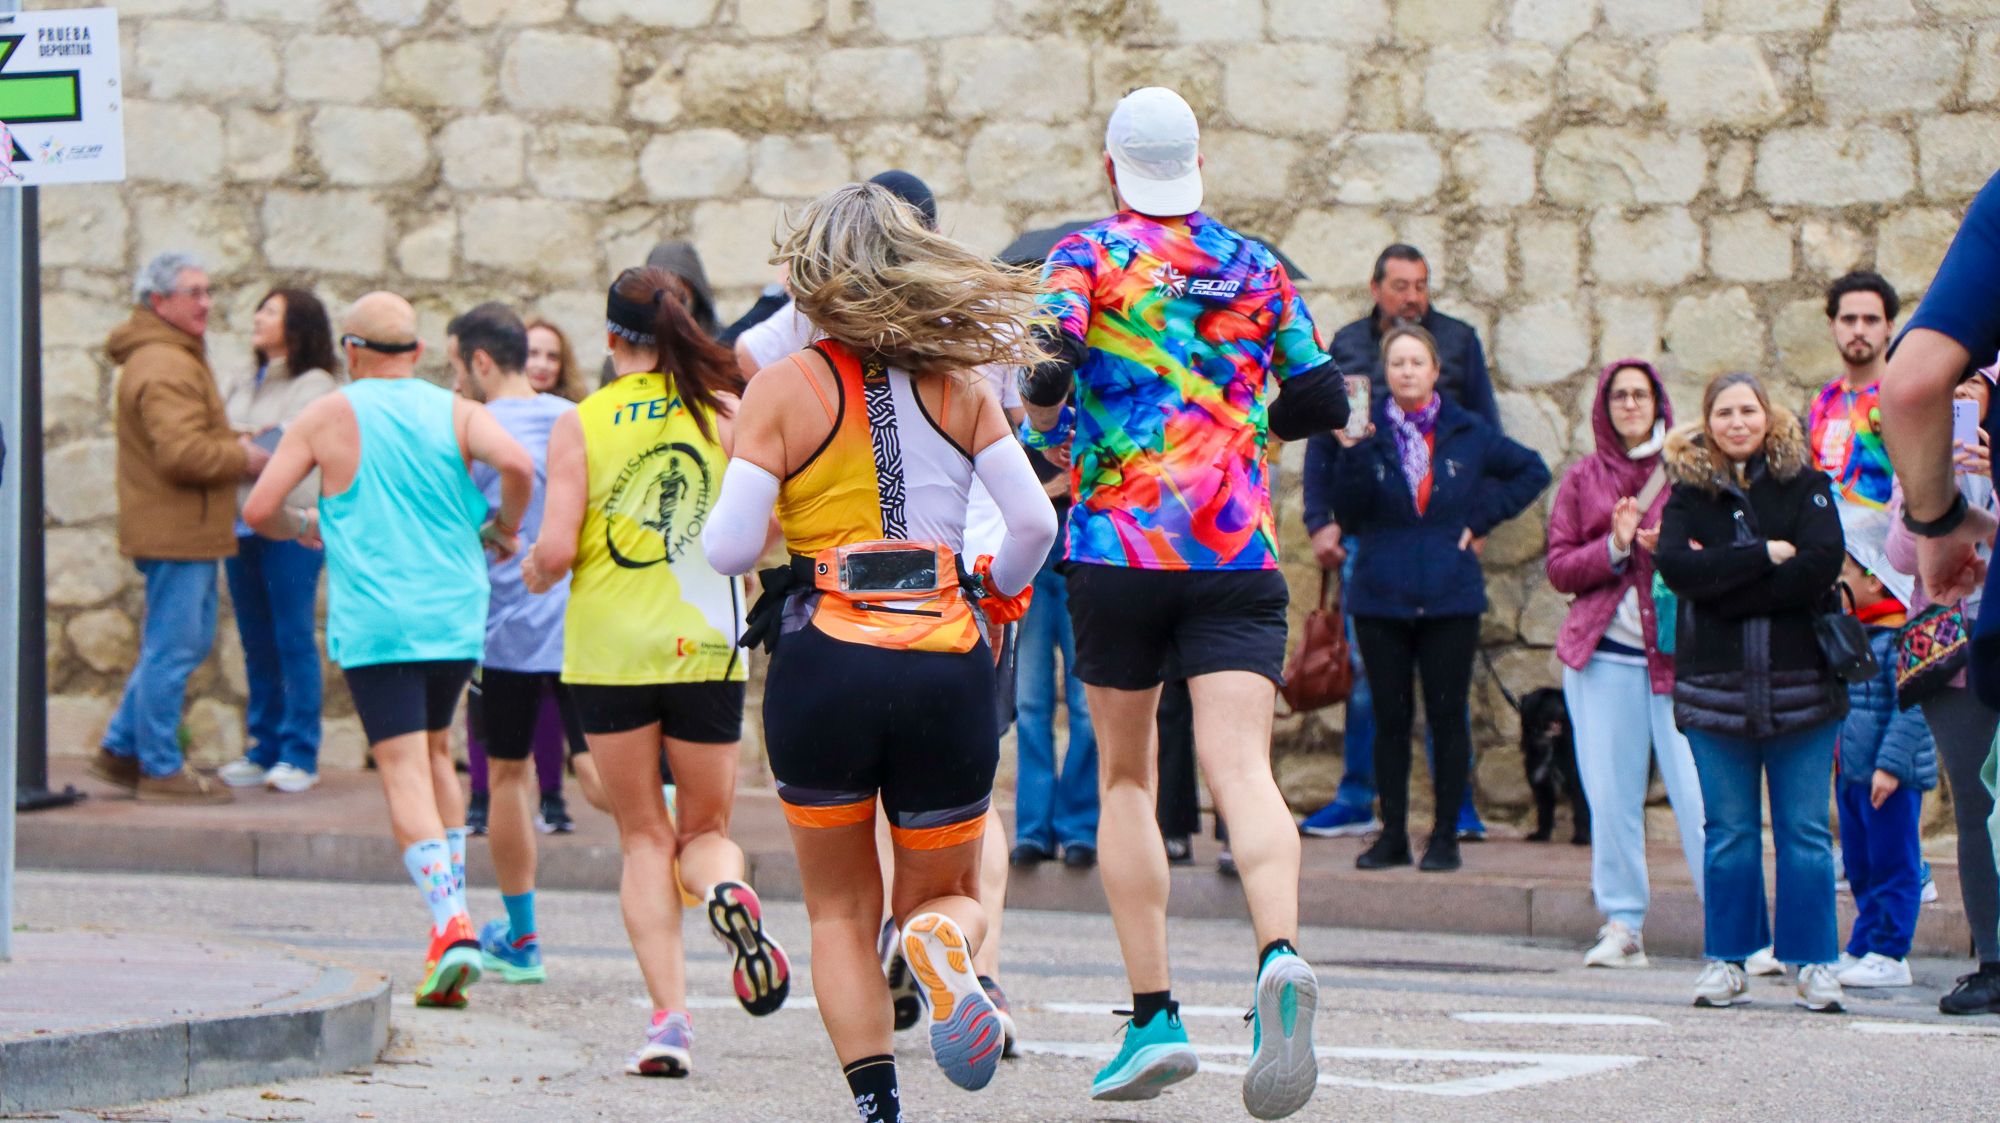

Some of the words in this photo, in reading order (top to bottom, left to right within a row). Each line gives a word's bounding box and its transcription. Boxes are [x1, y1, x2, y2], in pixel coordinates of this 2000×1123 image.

[38, 27, 91, 42] PRUEBA
[39, 43, 92, 57] DEPORTIVA
[1192, 279, 1240, 292] SOM
